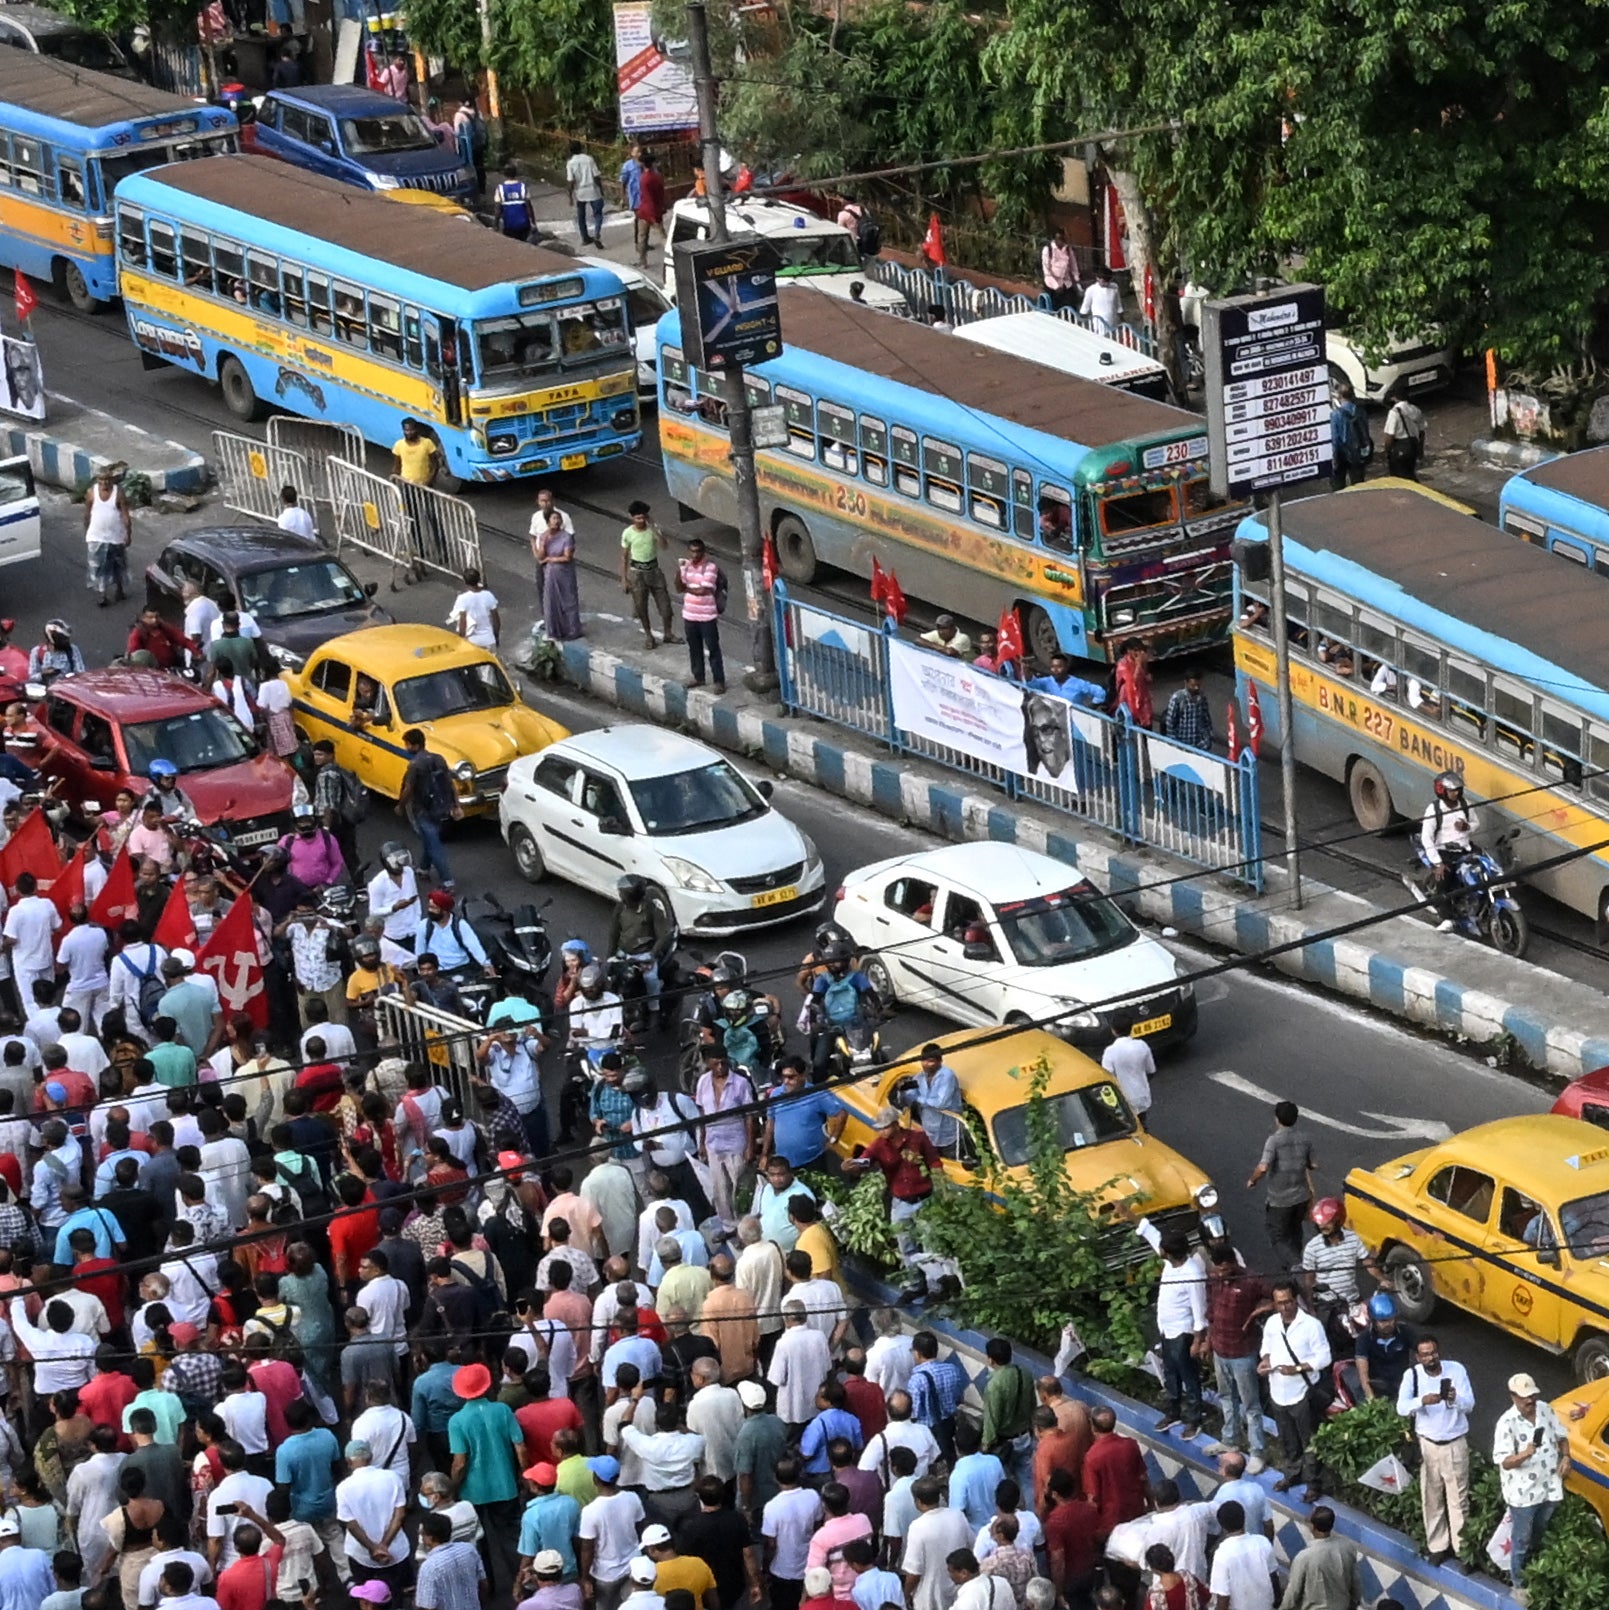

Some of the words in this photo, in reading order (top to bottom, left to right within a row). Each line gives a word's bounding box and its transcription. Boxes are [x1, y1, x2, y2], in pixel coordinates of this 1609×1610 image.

[549, 388, 580, 400] TATA
[1166, 442, 1189, 462] 230
[1364, 706, 1394, 742] 227
[1400, 721, 1466, 779] BANGUR
[1581, 1149, 1608, 1163] TAXI
